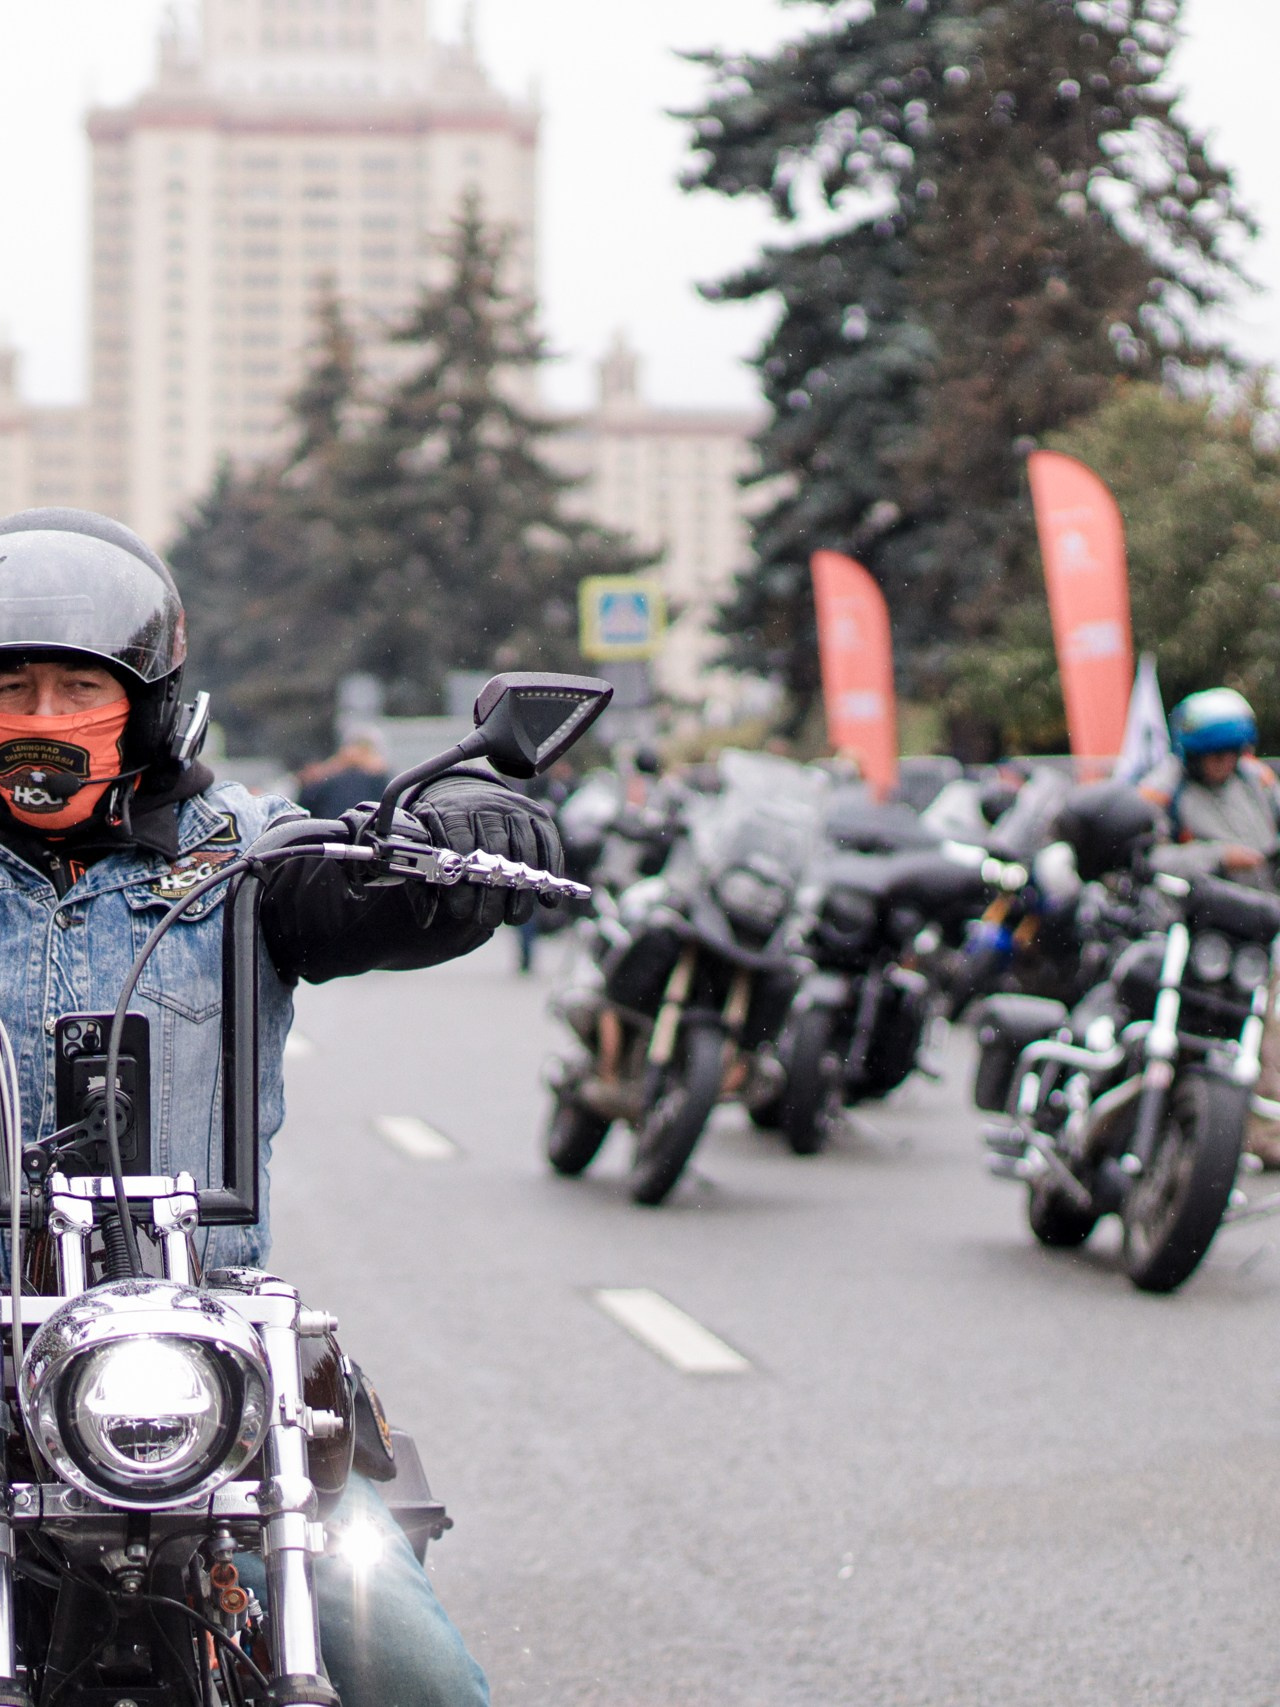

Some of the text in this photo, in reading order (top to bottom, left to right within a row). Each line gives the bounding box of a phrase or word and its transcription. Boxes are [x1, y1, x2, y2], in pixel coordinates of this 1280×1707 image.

[12, 744, 60, 754] LENINGRAD
[4, 752, 74, 766] CHAPTER RUSSIA
[160, 862, 213, 890] HOG
